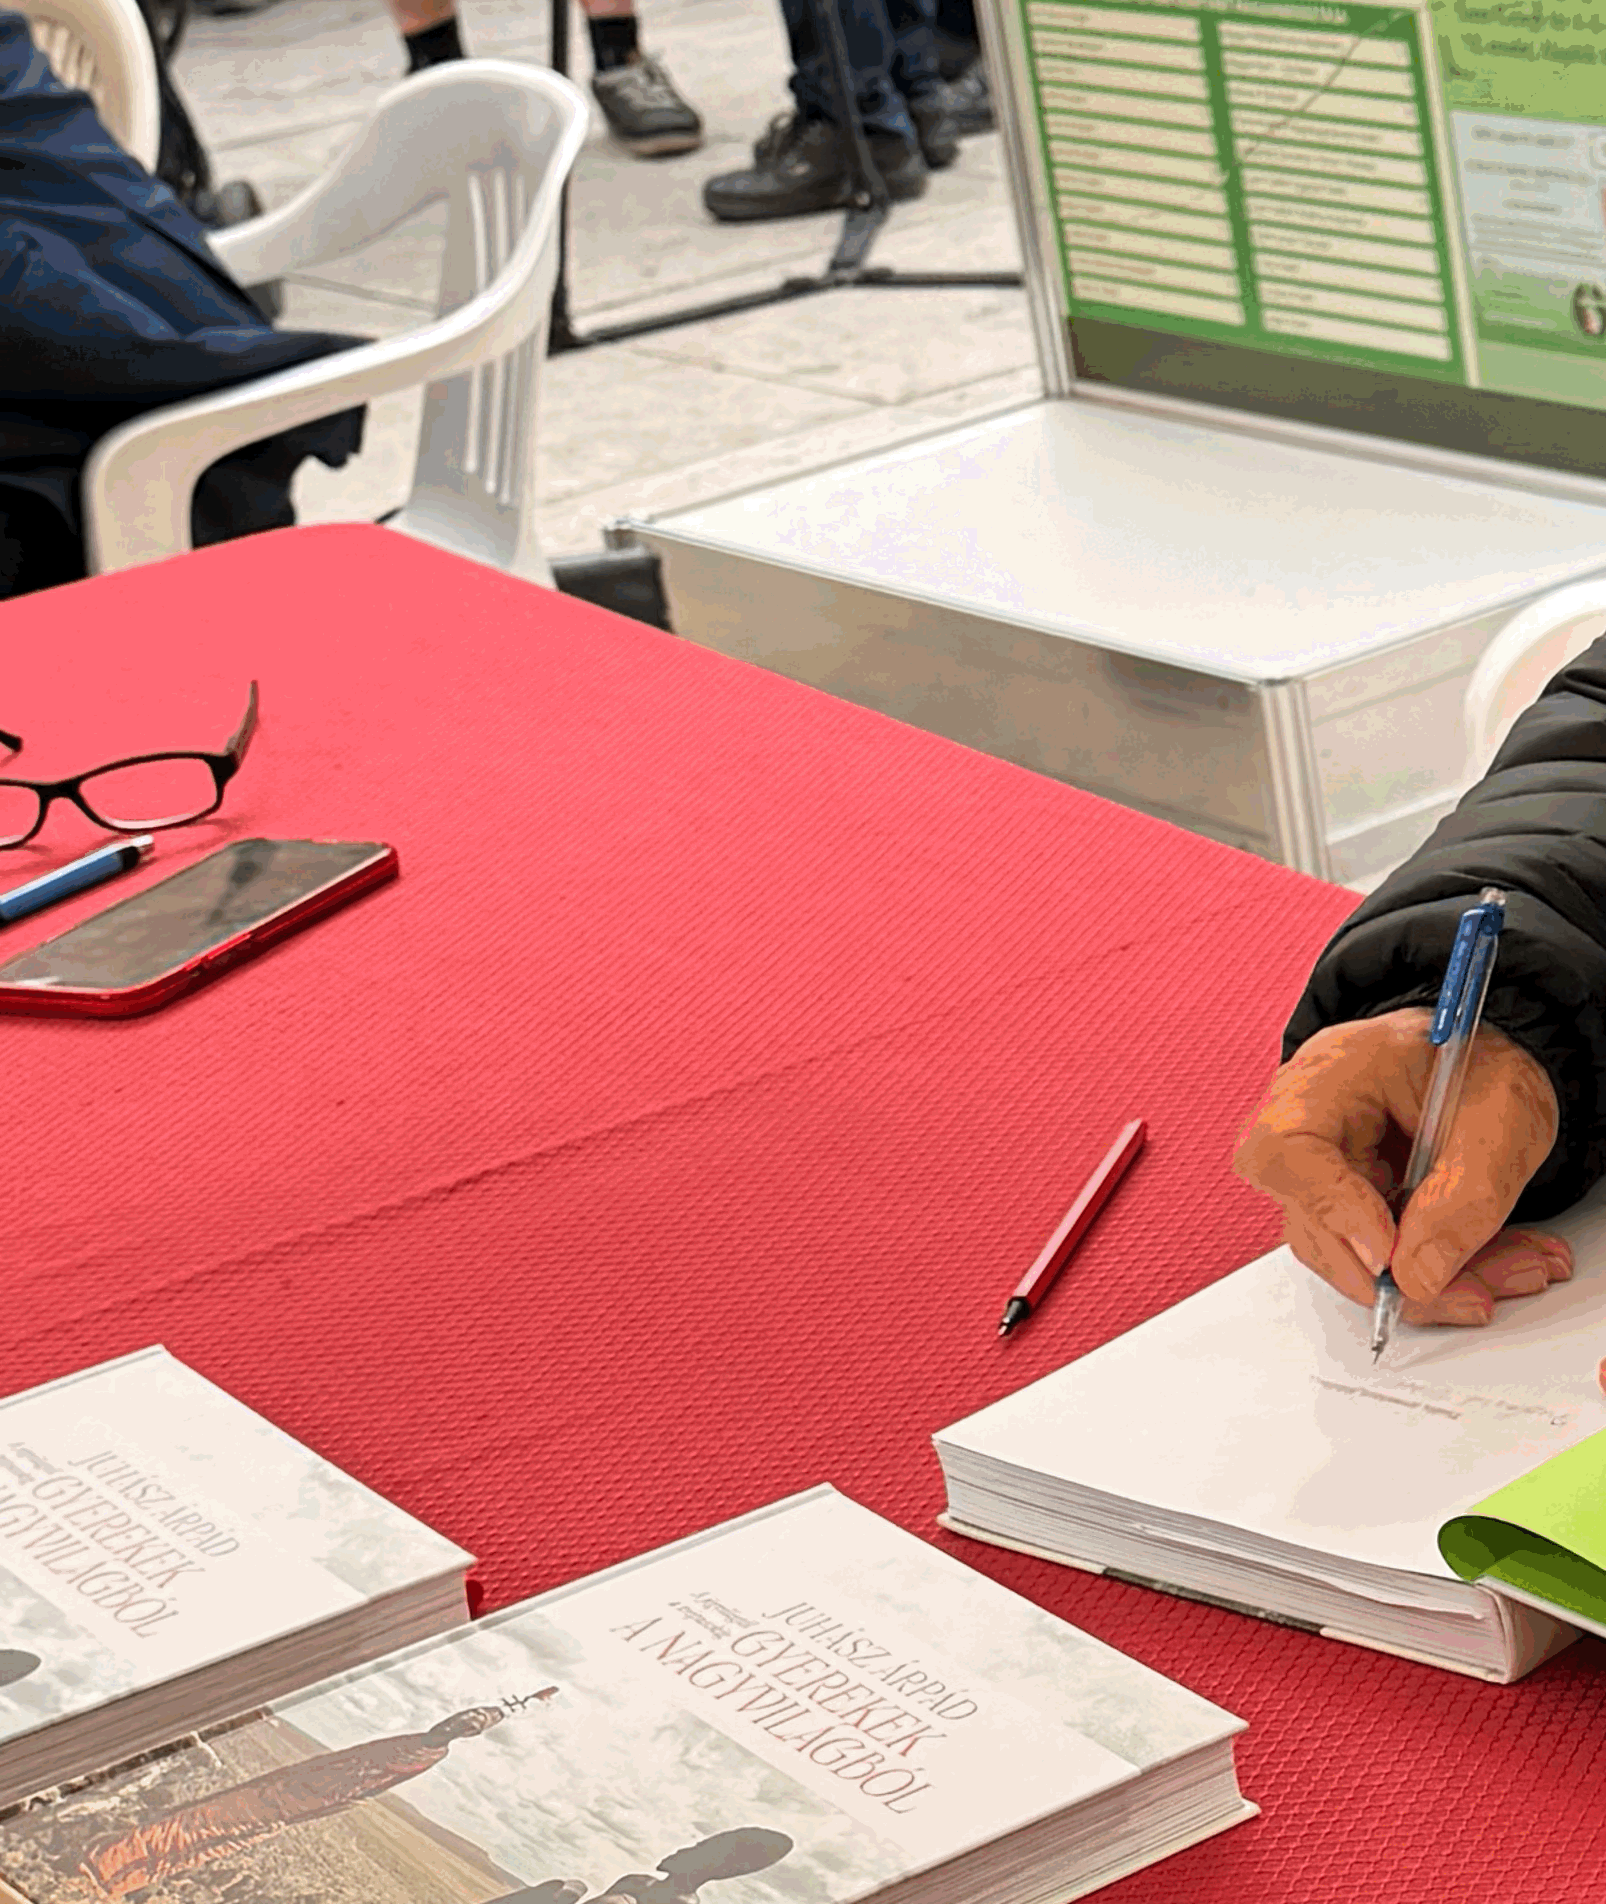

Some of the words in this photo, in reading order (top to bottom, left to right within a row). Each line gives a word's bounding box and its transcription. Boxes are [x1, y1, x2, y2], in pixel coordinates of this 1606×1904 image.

[32, 1476, 206, 1589] GYEREKEK
[67, 1450, 176, 1510] JUHÁSZ
[150, 1503, 240, 1557] ÁRPÁD
[609, 1617, 662, 1642] A
[639, 1631, 936, 1814] NAGYVILÁGBÓL
[731, 1630, 947, 1757] GYEREKEK
[762, 1602, 891, 1668] JUHÁSZ
[869, 1660, 978, 1720] ÁRPÁD
